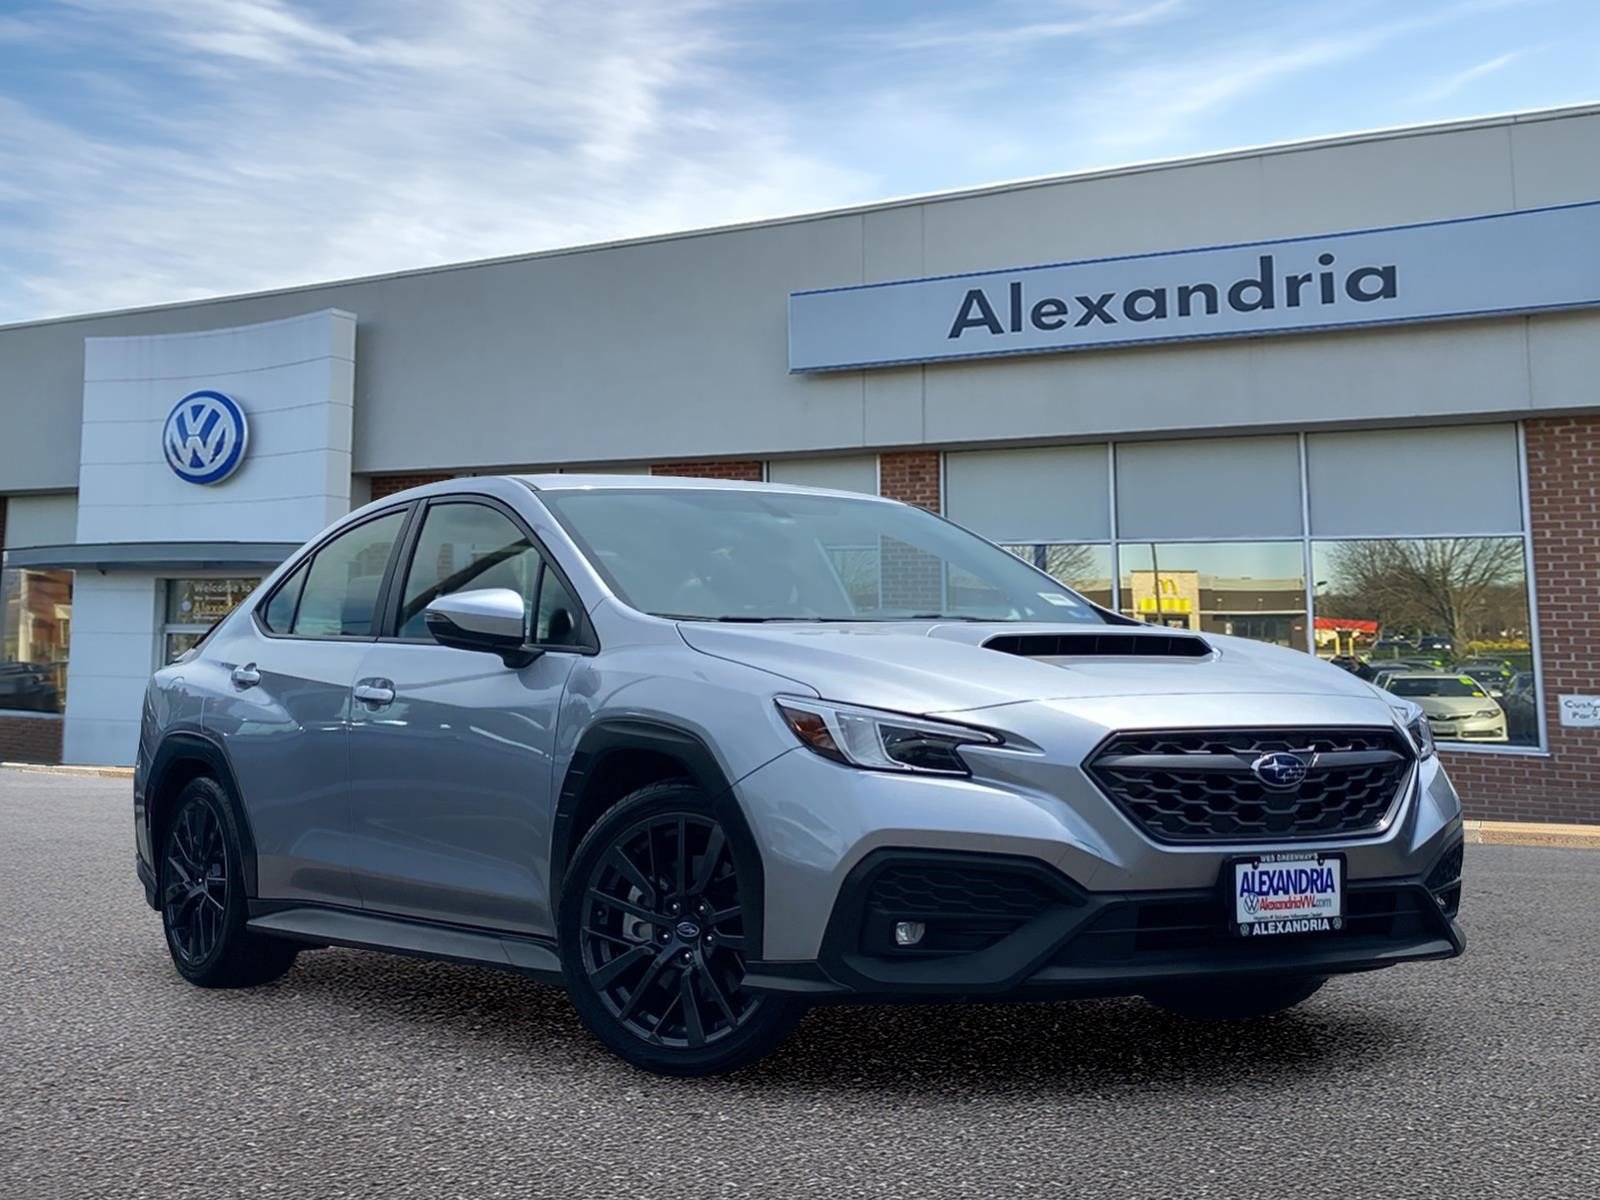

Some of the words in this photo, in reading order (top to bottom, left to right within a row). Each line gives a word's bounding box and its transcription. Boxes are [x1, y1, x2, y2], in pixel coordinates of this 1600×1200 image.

[948, 253, 1398, 339] Alexandria
[1240, 867, 1336, 897] ALEXANDRIA
[1252, 918, 1330, 936] ALEXANDRIA
